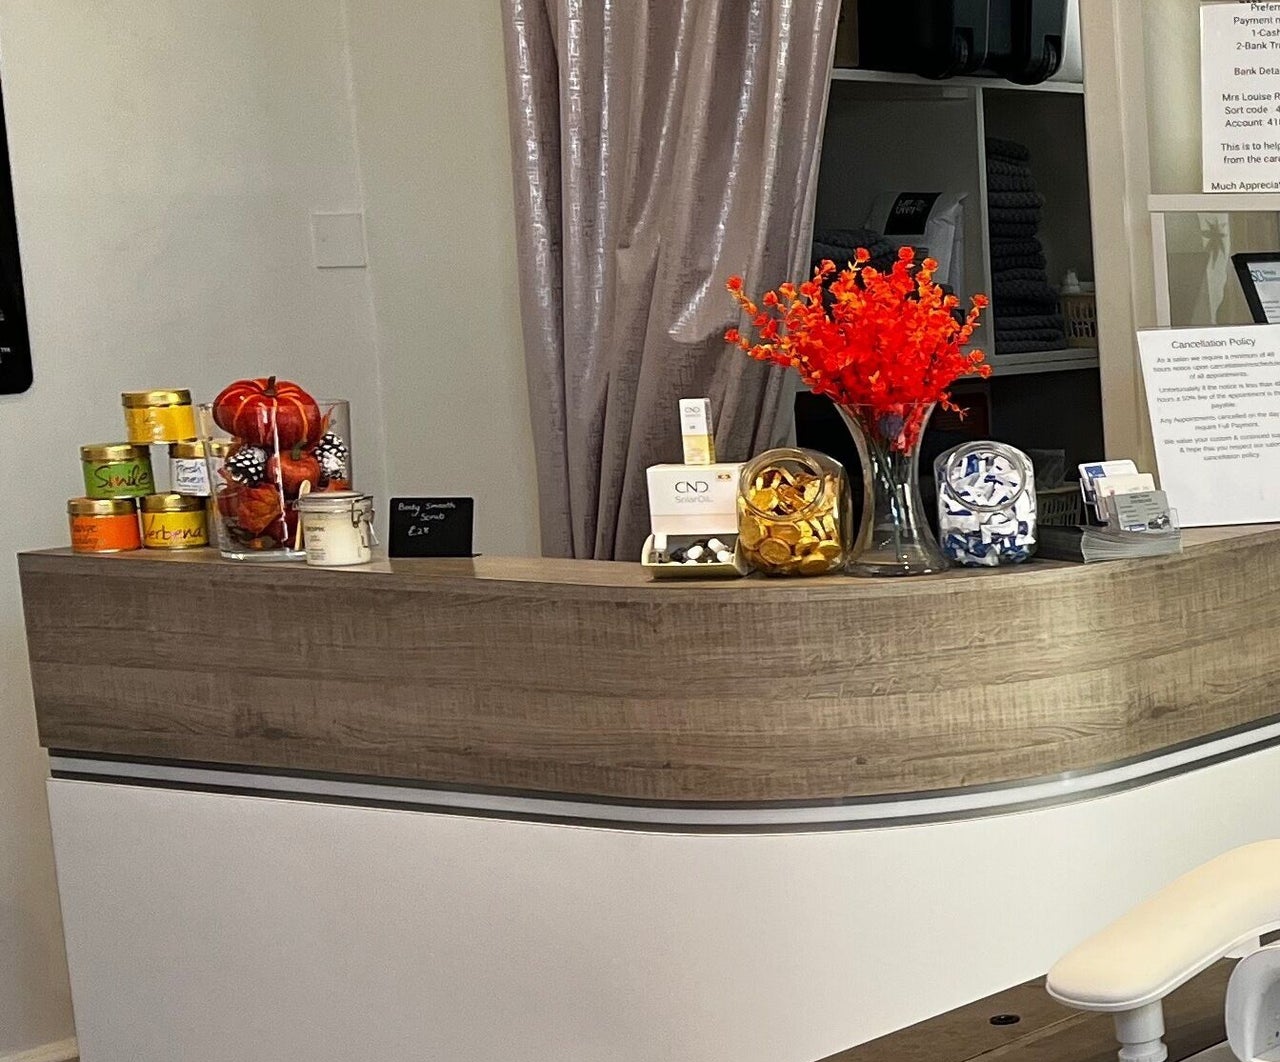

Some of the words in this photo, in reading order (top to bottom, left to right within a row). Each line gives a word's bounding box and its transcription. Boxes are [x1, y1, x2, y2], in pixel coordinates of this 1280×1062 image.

[1233, 16, 1273, 26] Payment
[1236, 42, 1267, 50] 2-Bank
[1234, 67, 1256, 76] Bank
[1242, 92, 1271, 101] Louise
[1225, 106, 1243, 115] Sort
[1246, 105, 1268, 114] code
[1225, 119, 1262, 127] Account
[1221, 143, 1239, 151] This
[1242, 143, 1250, 151] is
[1224, 155, 1244, 164] from
[1247, 155, 1261, 163] the
[1211, 182, 1237, 190] Much
[1171, 340, 1226, 349] Cancellation
[1229, 338, 1256, 347] Policy
[675, 481, 709, 494] CND
